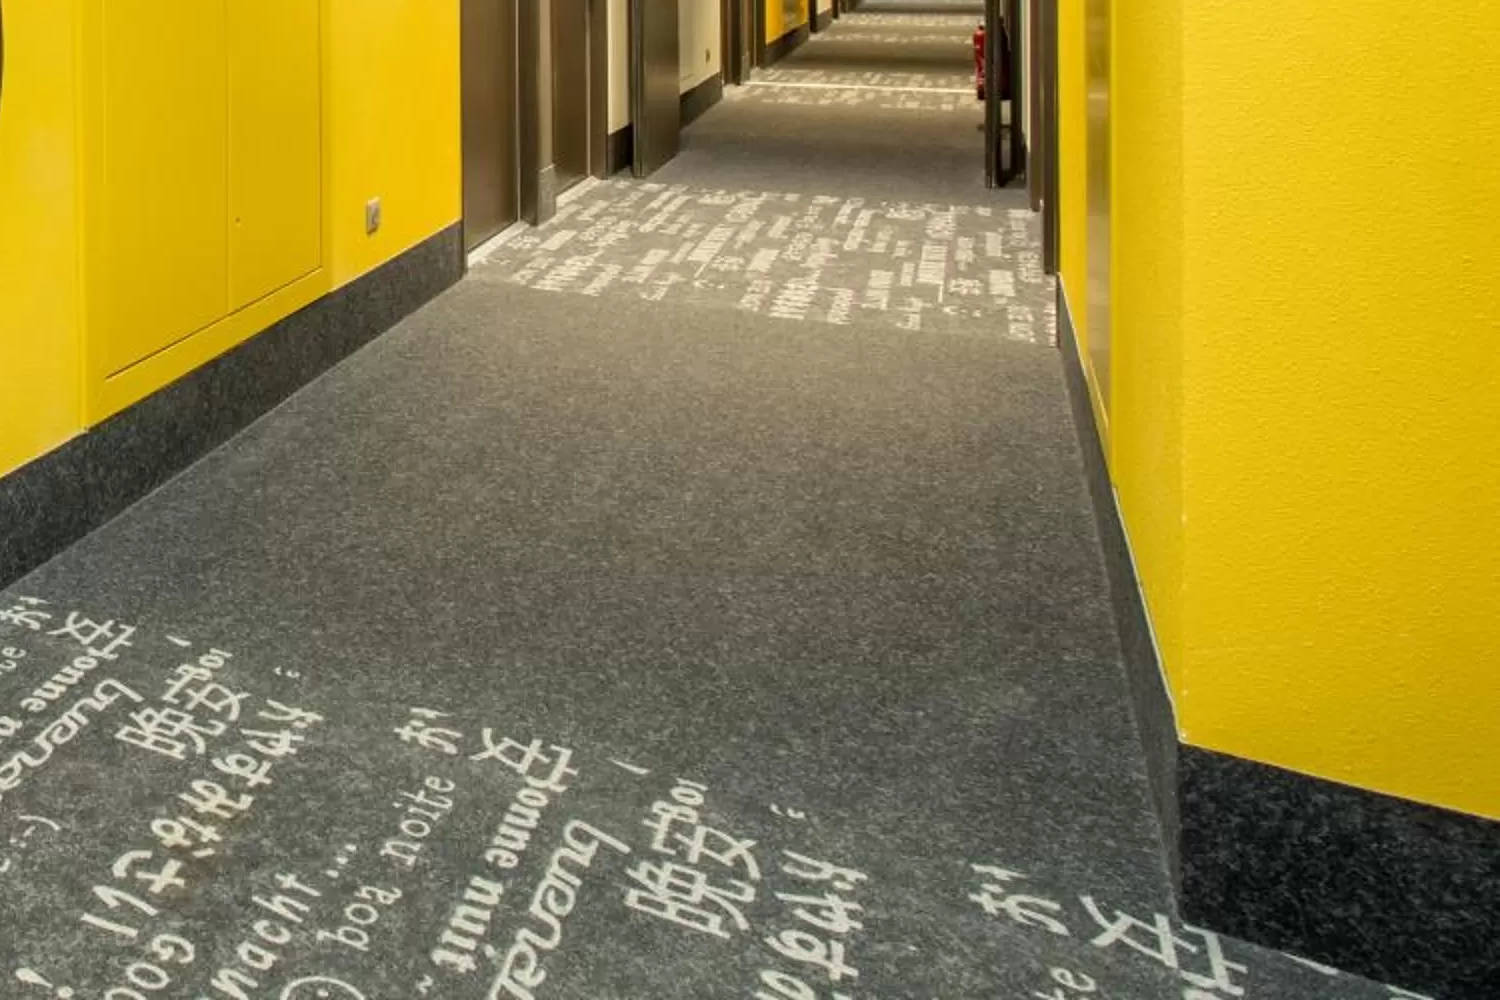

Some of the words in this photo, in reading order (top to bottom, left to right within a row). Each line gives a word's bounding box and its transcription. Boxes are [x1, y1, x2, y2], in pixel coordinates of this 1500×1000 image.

[198, 844, 357, 1000] nacht...
[316, 885, 401, 951] boa
[379, 775, 455, 867] noite
[431, 875, 503, 973] nuit
